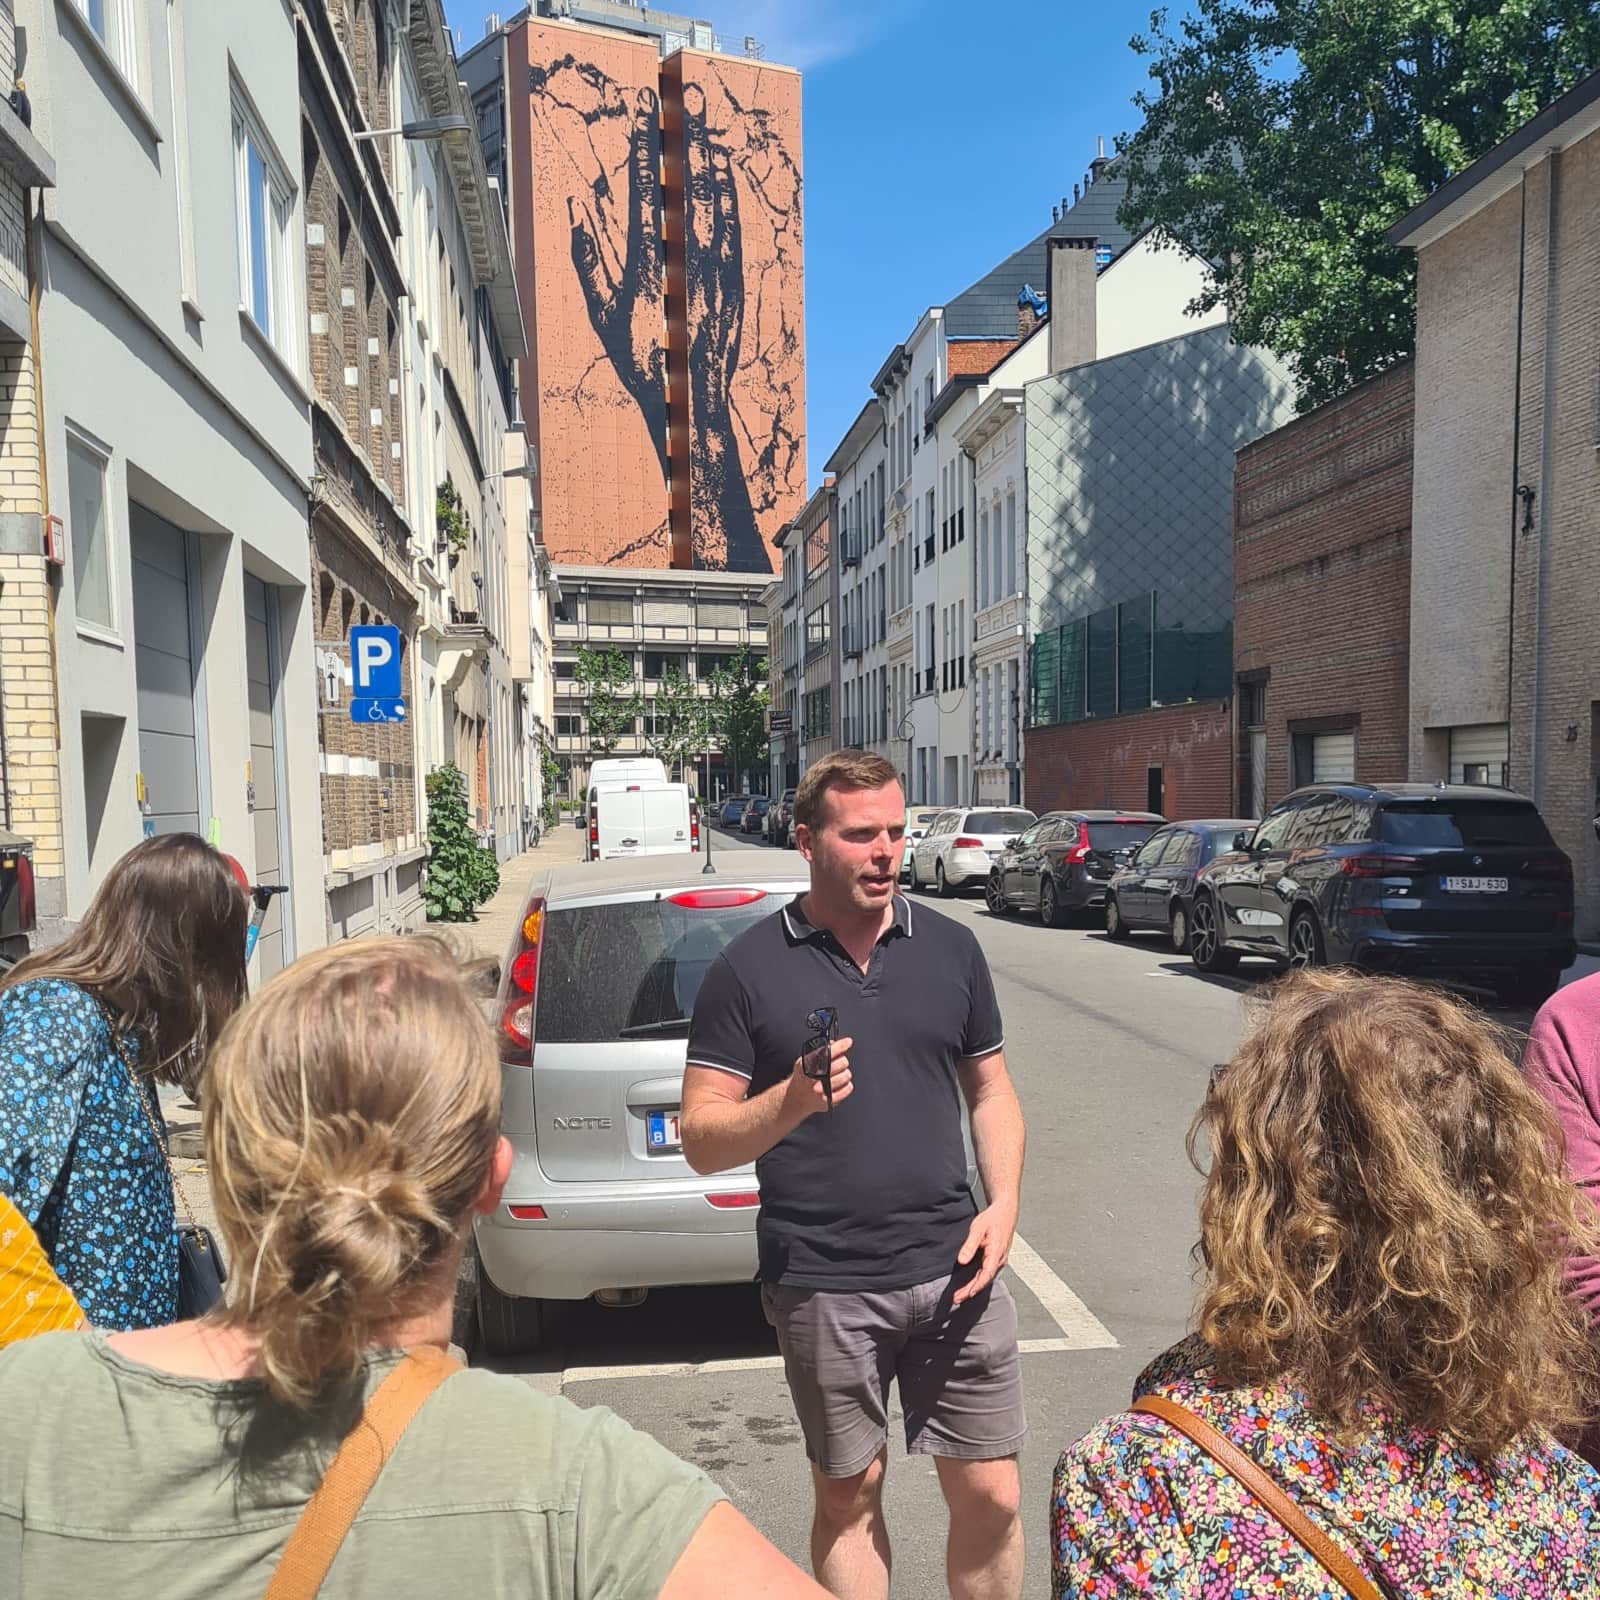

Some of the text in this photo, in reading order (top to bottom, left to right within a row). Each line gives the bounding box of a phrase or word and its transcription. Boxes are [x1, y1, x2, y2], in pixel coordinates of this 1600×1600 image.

[358, 637, 391, 686] P
[553, 1117, 613, 1130] NOTE
[654, 1132, 664, 1143] B
